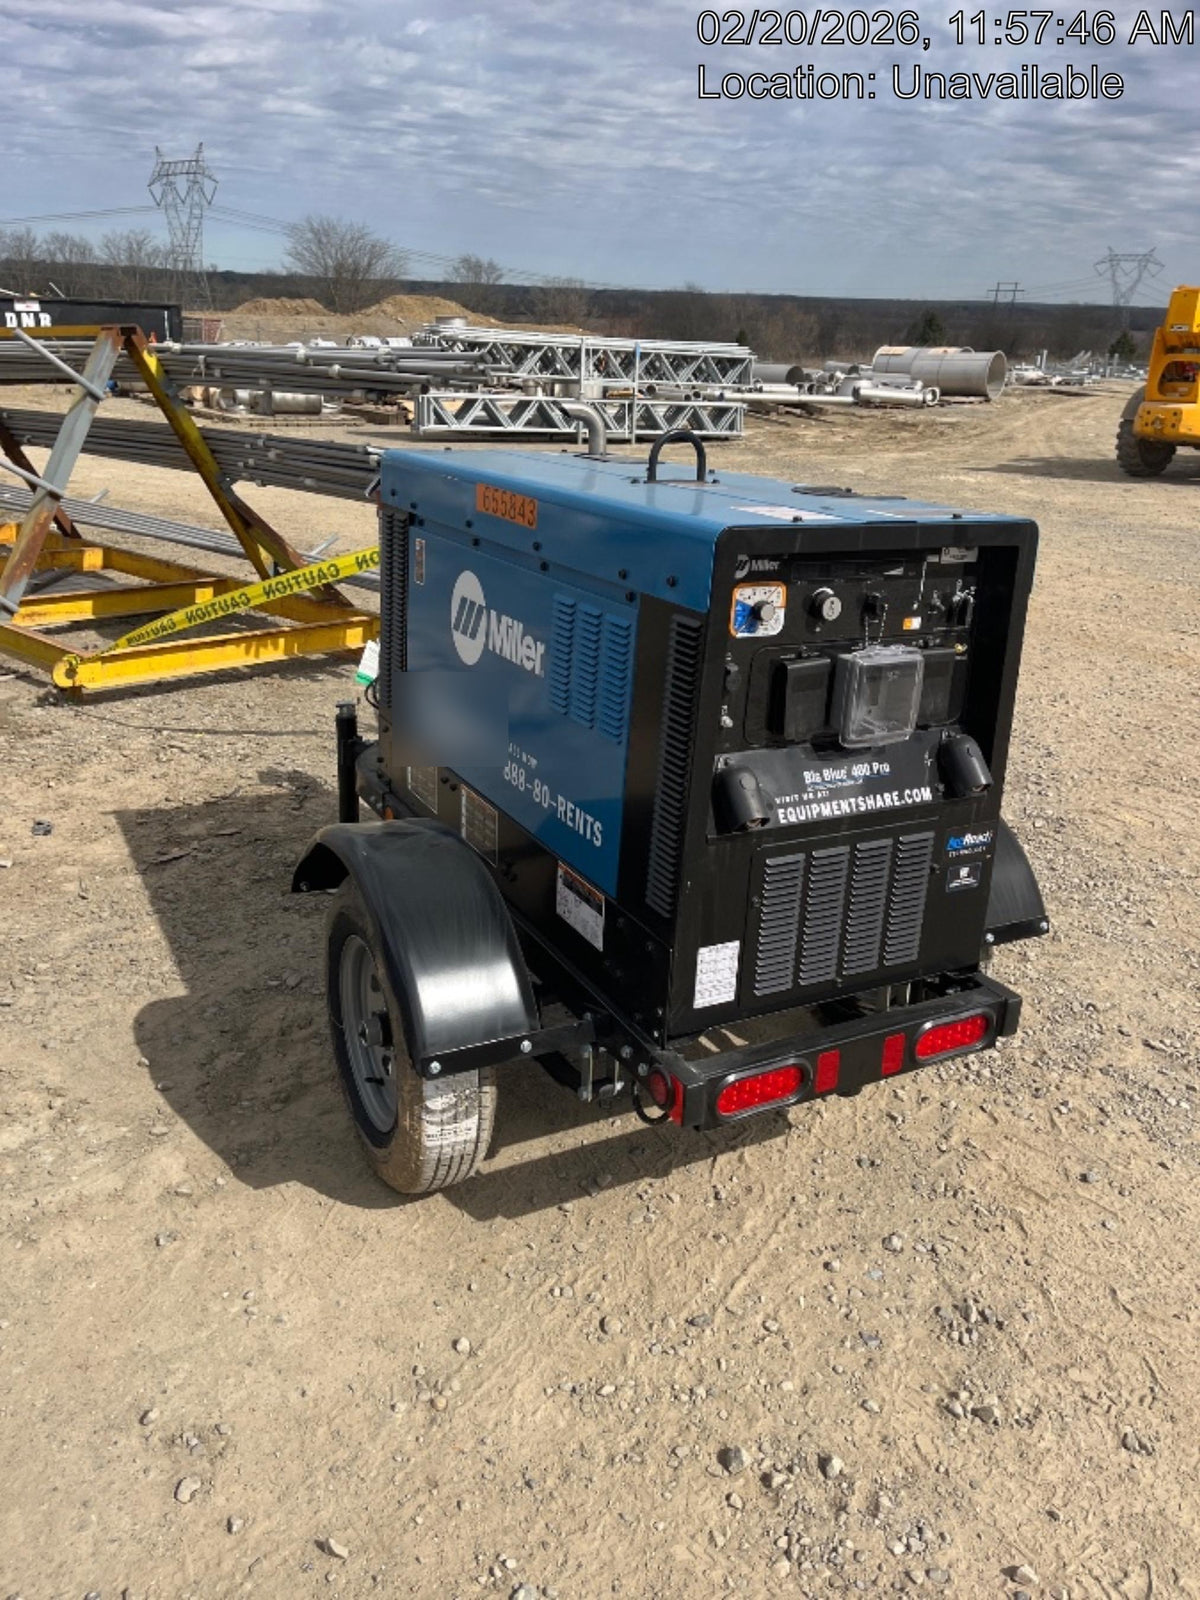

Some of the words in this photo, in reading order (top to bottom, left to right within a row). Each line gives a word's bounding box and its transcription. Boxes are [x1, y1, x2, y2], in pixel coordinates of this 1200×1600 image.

[483, 486, 537, 527] 655843
[750, 559, 781, 571] Miller
[488, 609, 545, 675] Miller
[777, 786, 933, 824] EQUIPMENTSHARE.COM
